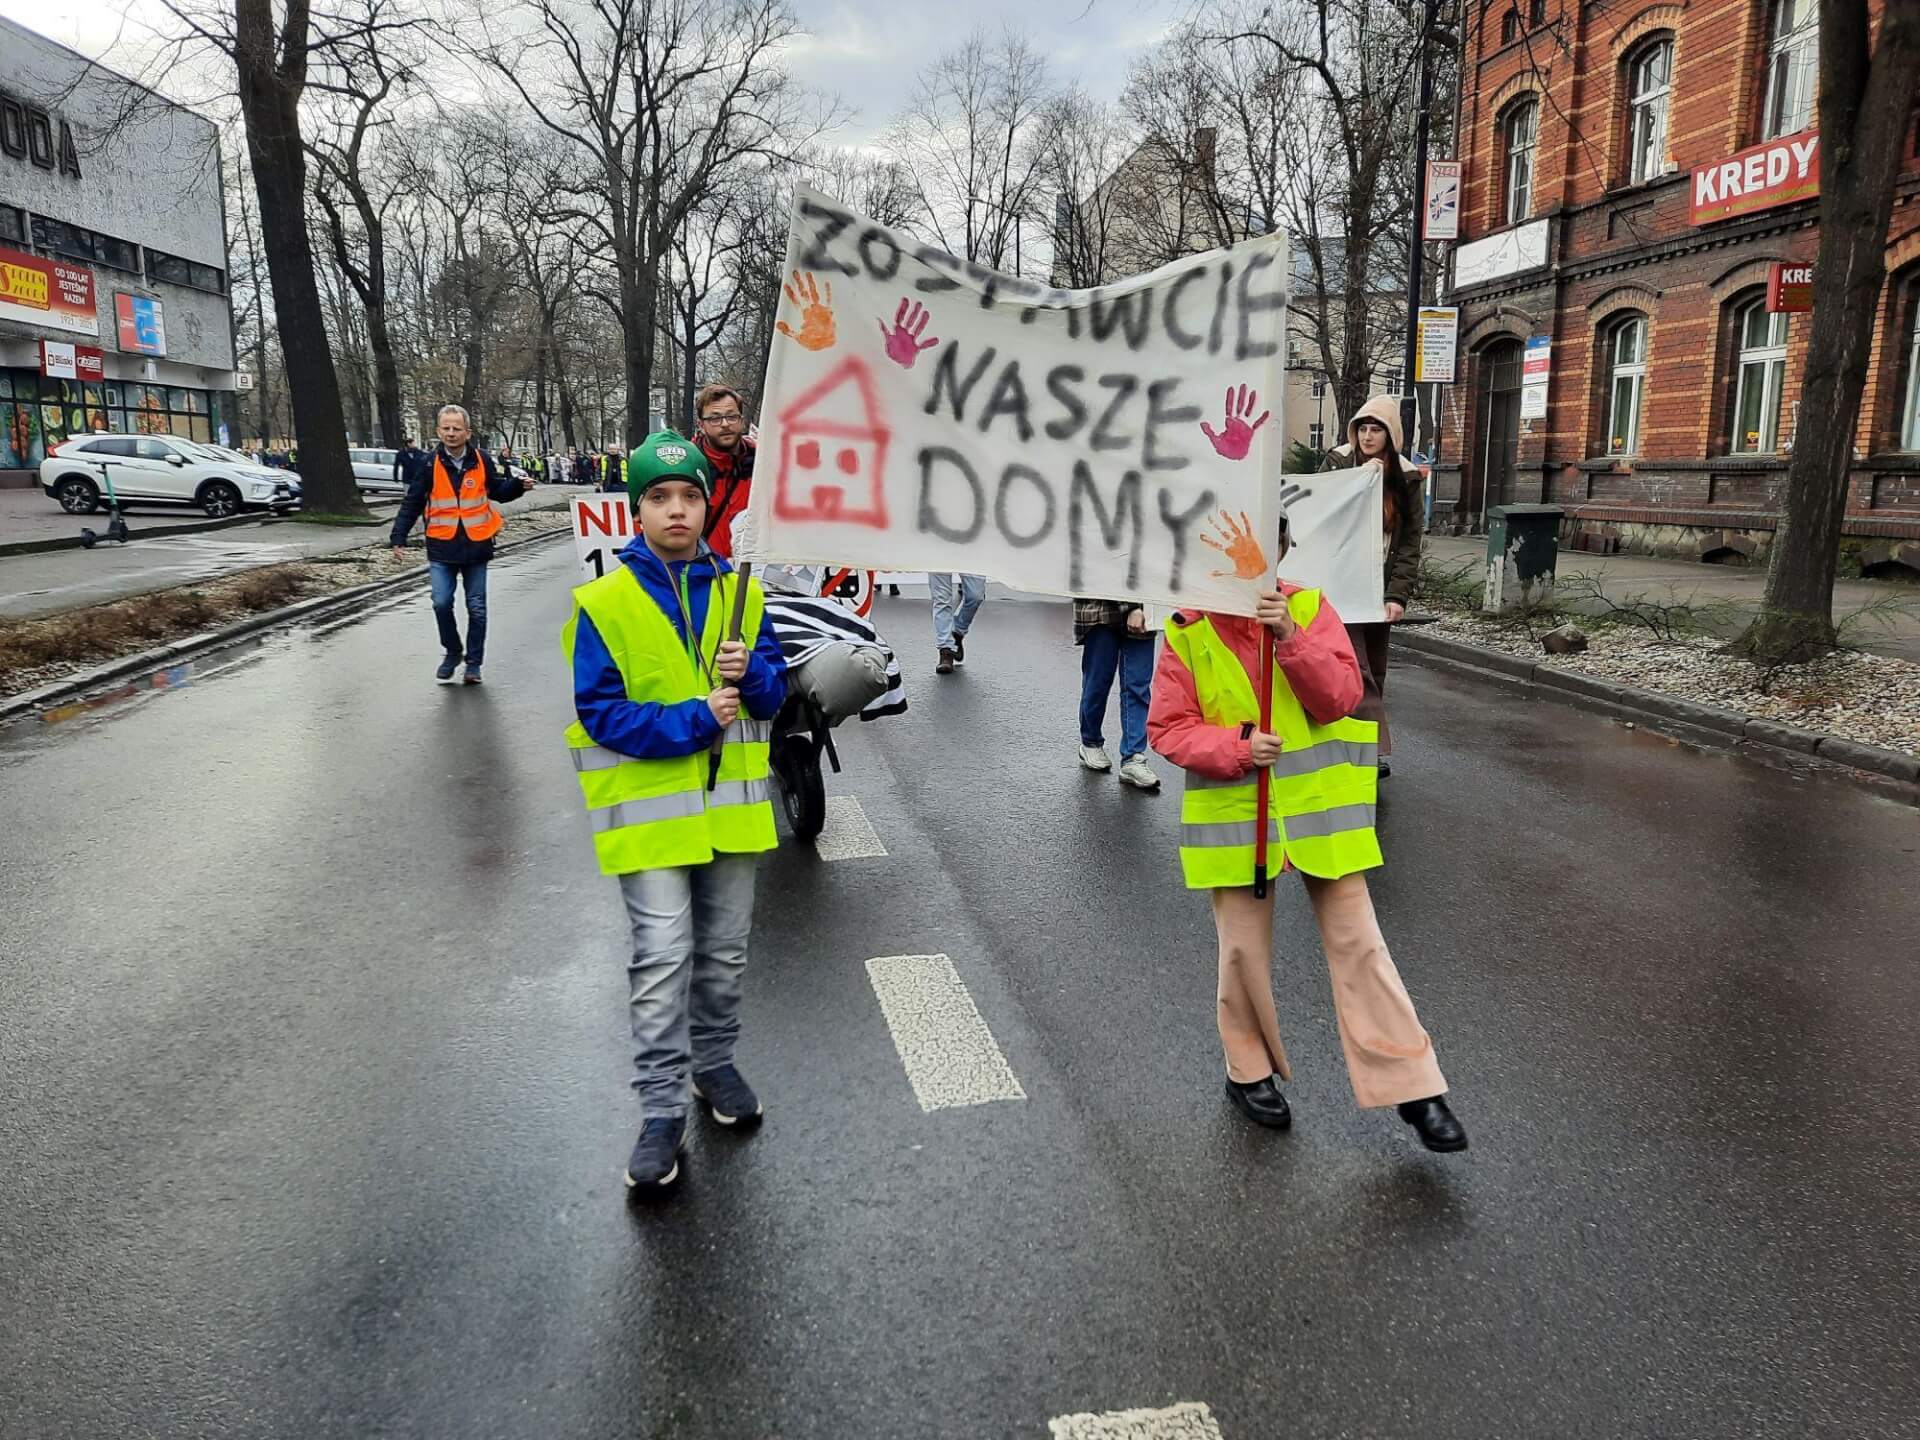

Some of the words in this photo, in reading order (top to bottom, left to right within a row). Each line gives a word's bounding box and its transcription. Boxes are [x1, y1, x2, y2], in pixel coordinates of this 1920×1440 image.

[1696, 136, 1819, 206] KREDY
[66, 270, 77, 281] 100
[1782, 268, 1813, 284] KRE
[923, 339, 1202, 471] NASZE
[577, 501, 643, 537] NI
[917, 444, 1215, 592] DOMY
